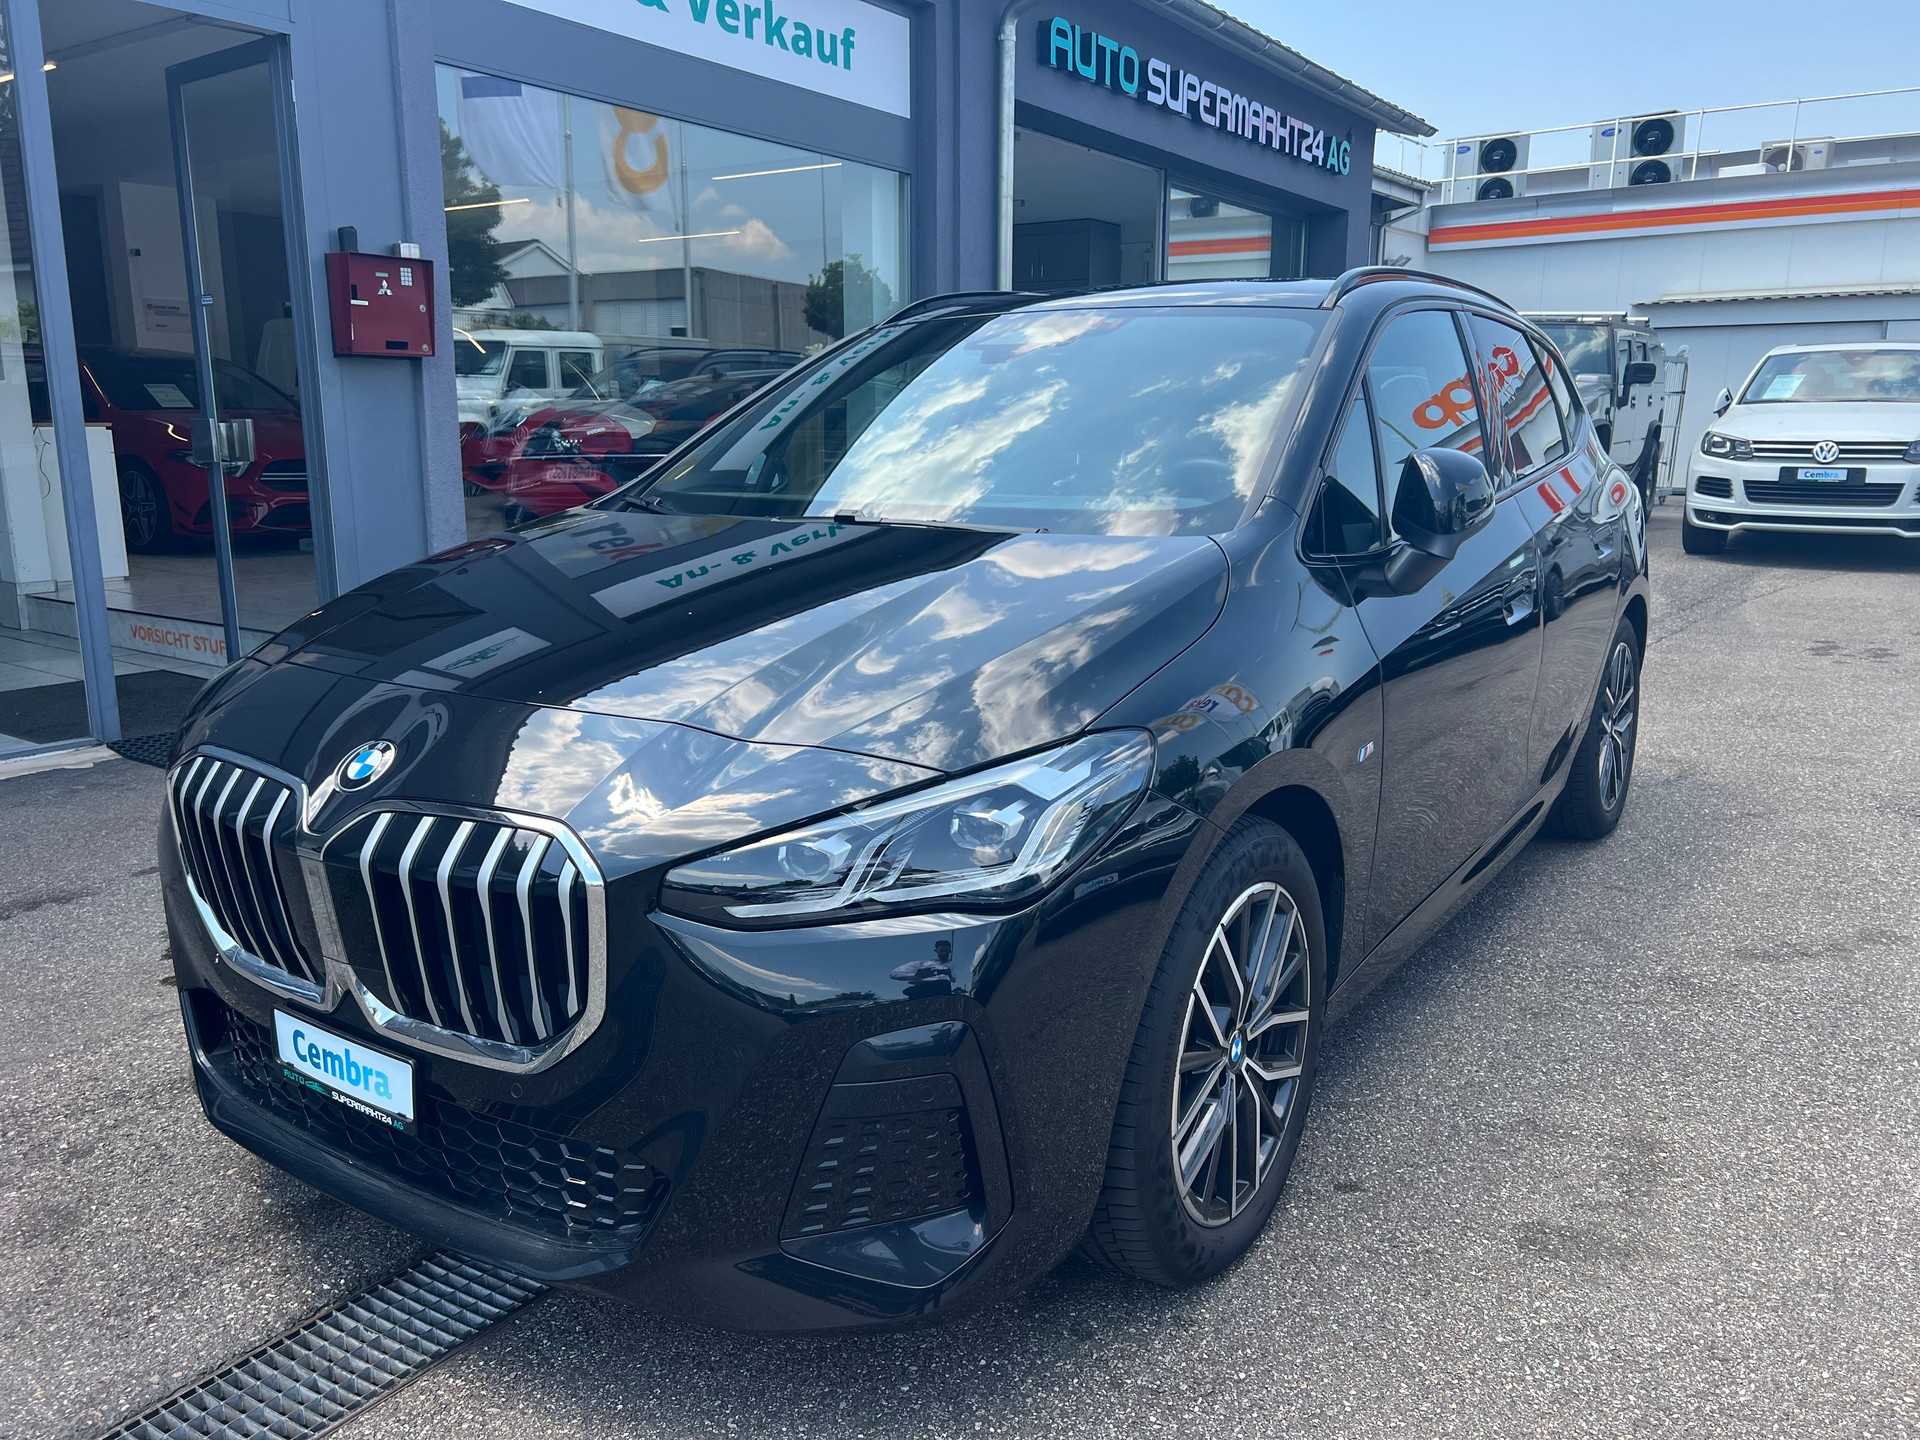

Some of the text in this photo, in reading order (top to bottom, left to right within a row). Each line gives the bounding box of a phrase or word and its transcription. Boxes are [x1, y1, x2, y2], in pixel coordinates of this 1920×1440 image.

[1050, 16, 1350, 177] AUTO SUPERMARKT24 AG
[1804, 470, 1840, 479] Cembra
[129, 624, 190, 649] VORSICHT
[292, 1029, 393, 1101] Cembra
[283, 1068, 404, 1131] AUTO SUPERMARKT24 AG
